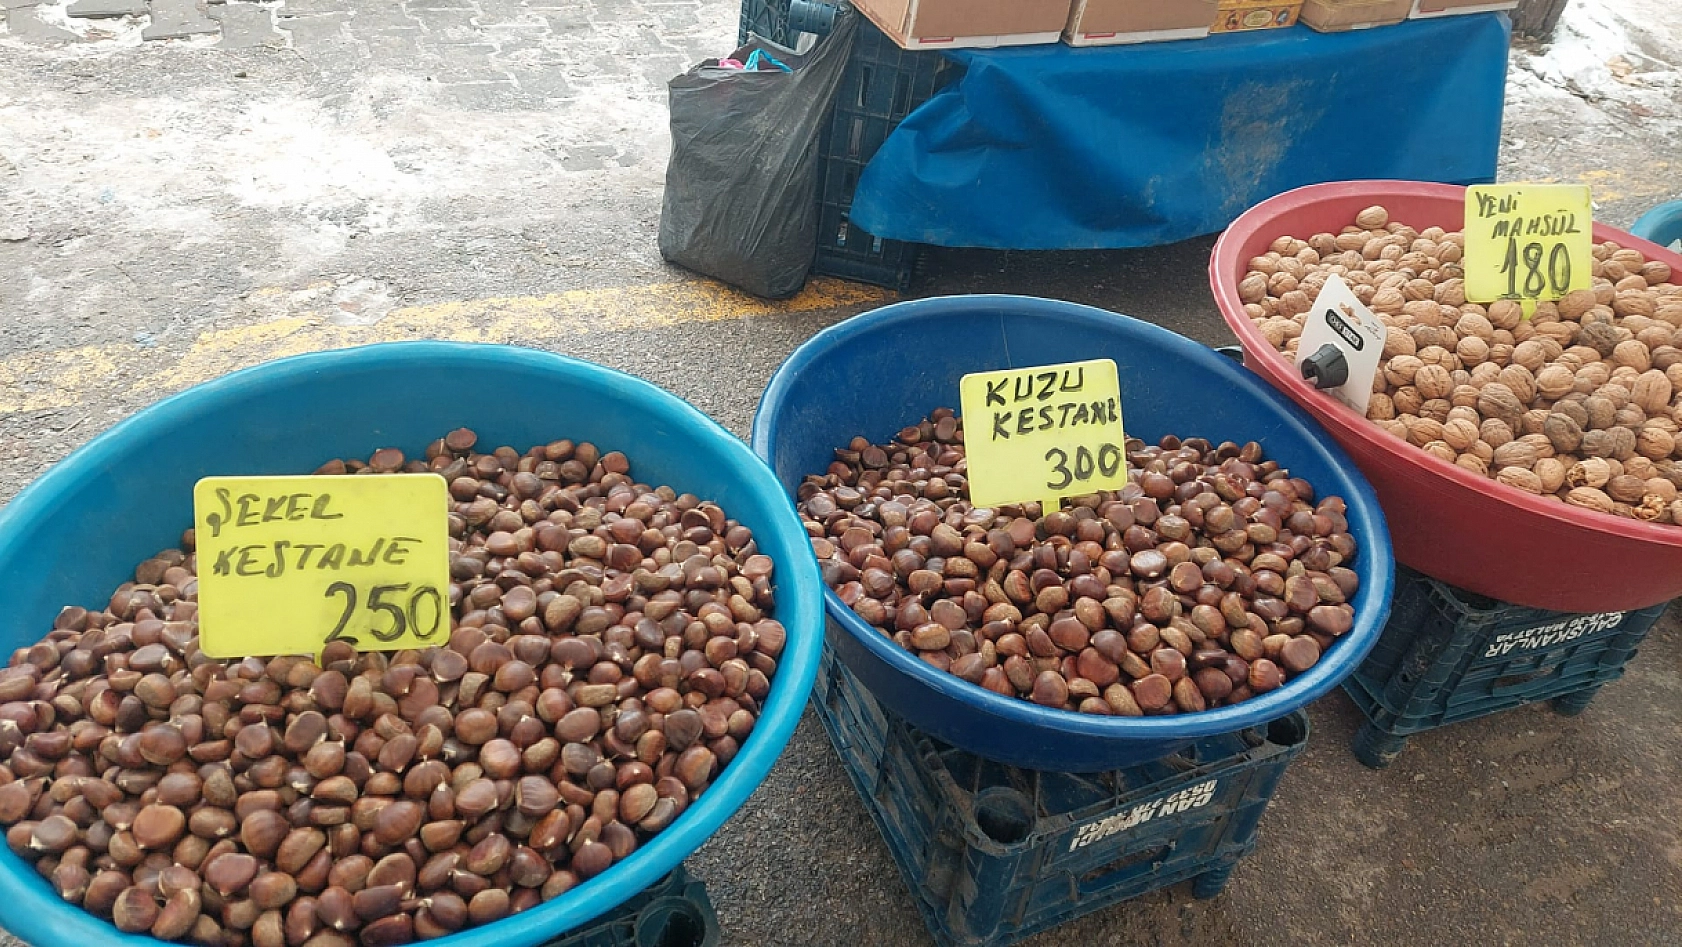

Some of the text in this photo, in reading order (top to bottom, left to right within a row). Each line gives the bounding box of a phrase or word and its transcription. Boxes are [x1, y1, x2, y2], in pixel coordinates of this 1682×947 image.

[1491, 209, 1581, 239] MAHSÜL
[1497, 236, 1571, 300] 180
[986, 367, 1083, 407] KUZU
[993, 397, 1118, 441] KESTANE
[1045, 442, 1121, 490] 300
[213, 537, 422, 578] KESTANE
[324, 580, 441, 645] 250
